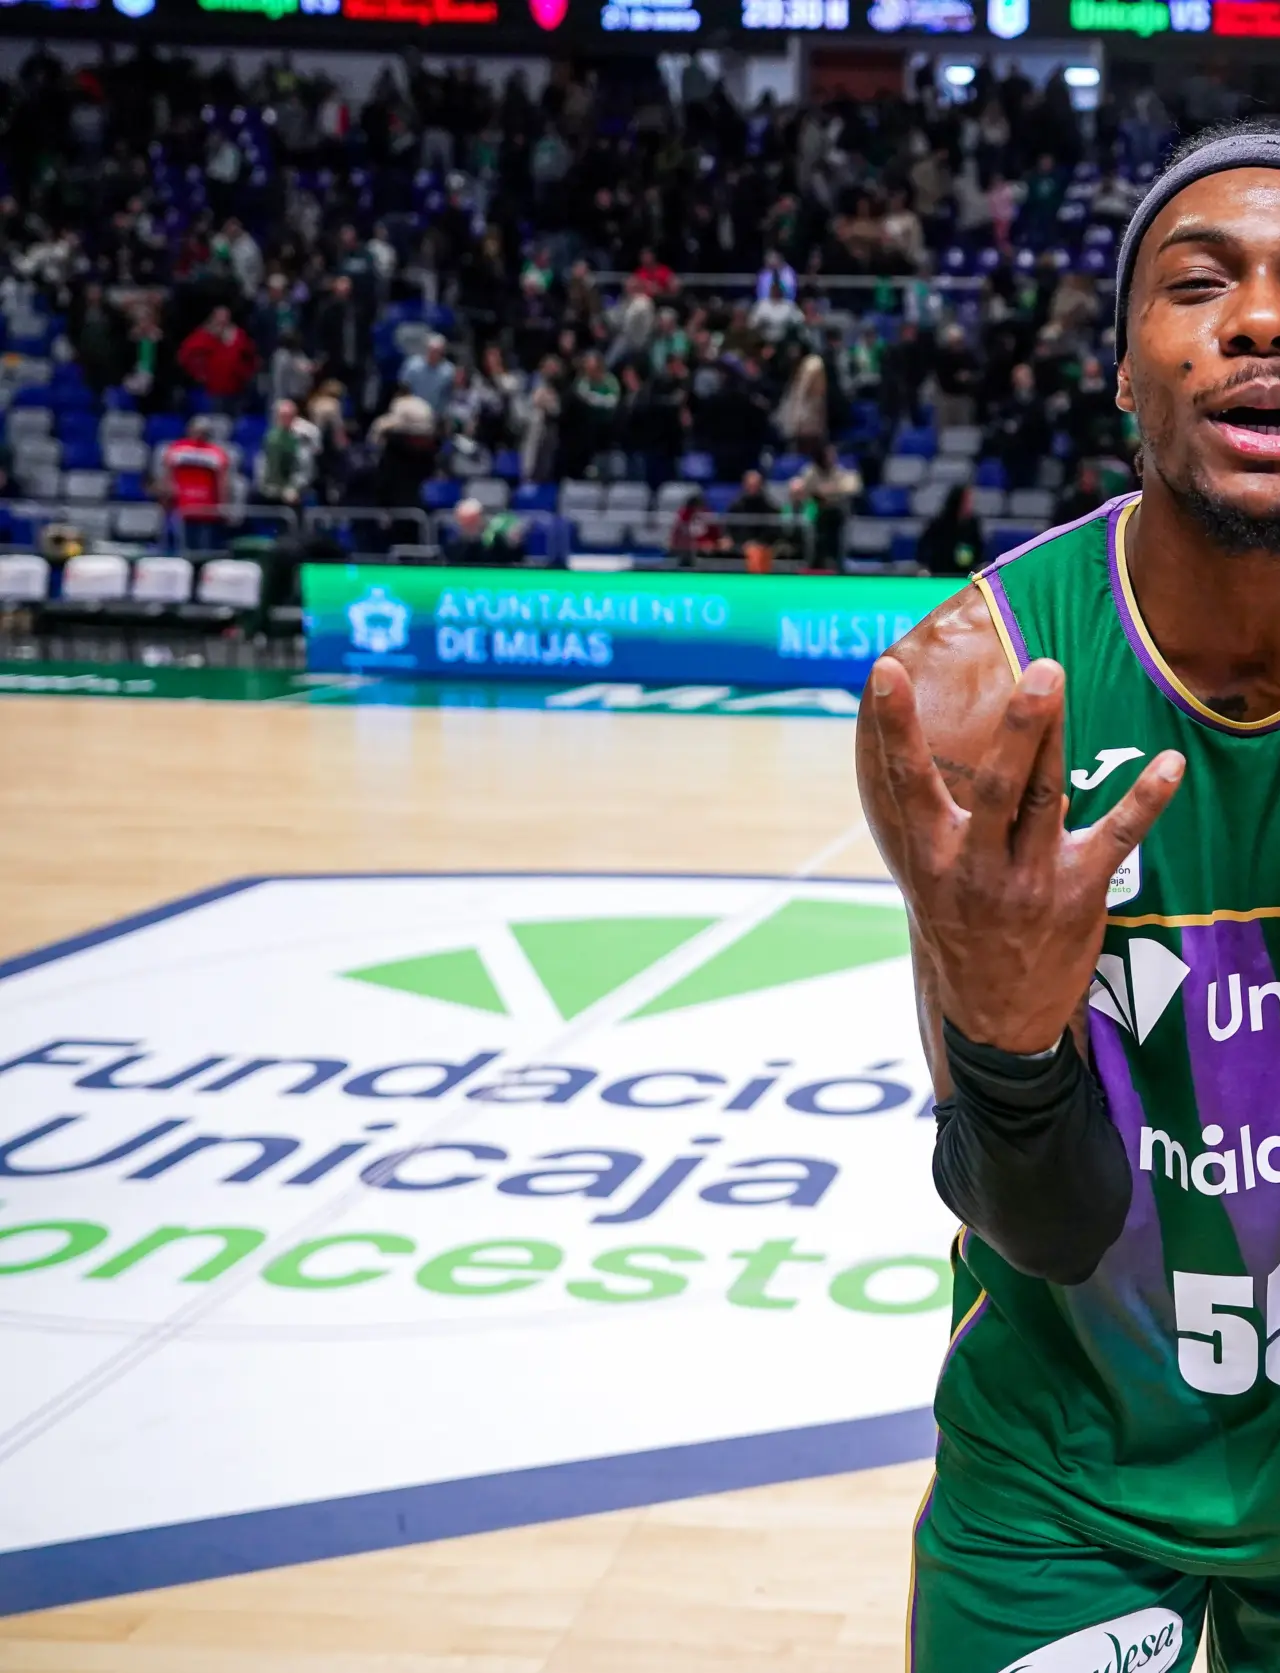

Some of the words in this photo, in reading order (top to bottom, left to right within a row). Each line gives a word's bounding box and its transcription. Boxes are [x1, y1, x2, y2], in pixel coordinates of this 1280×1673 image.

[436, 626, 487, 663] DE
[492, 629, 613, 666] MIJAS
[0, 1039, 936, 1120] Fundació
[0, 1112, 841, 1224] Unicaja
[0, 1216, 954, 1315] oncesto
